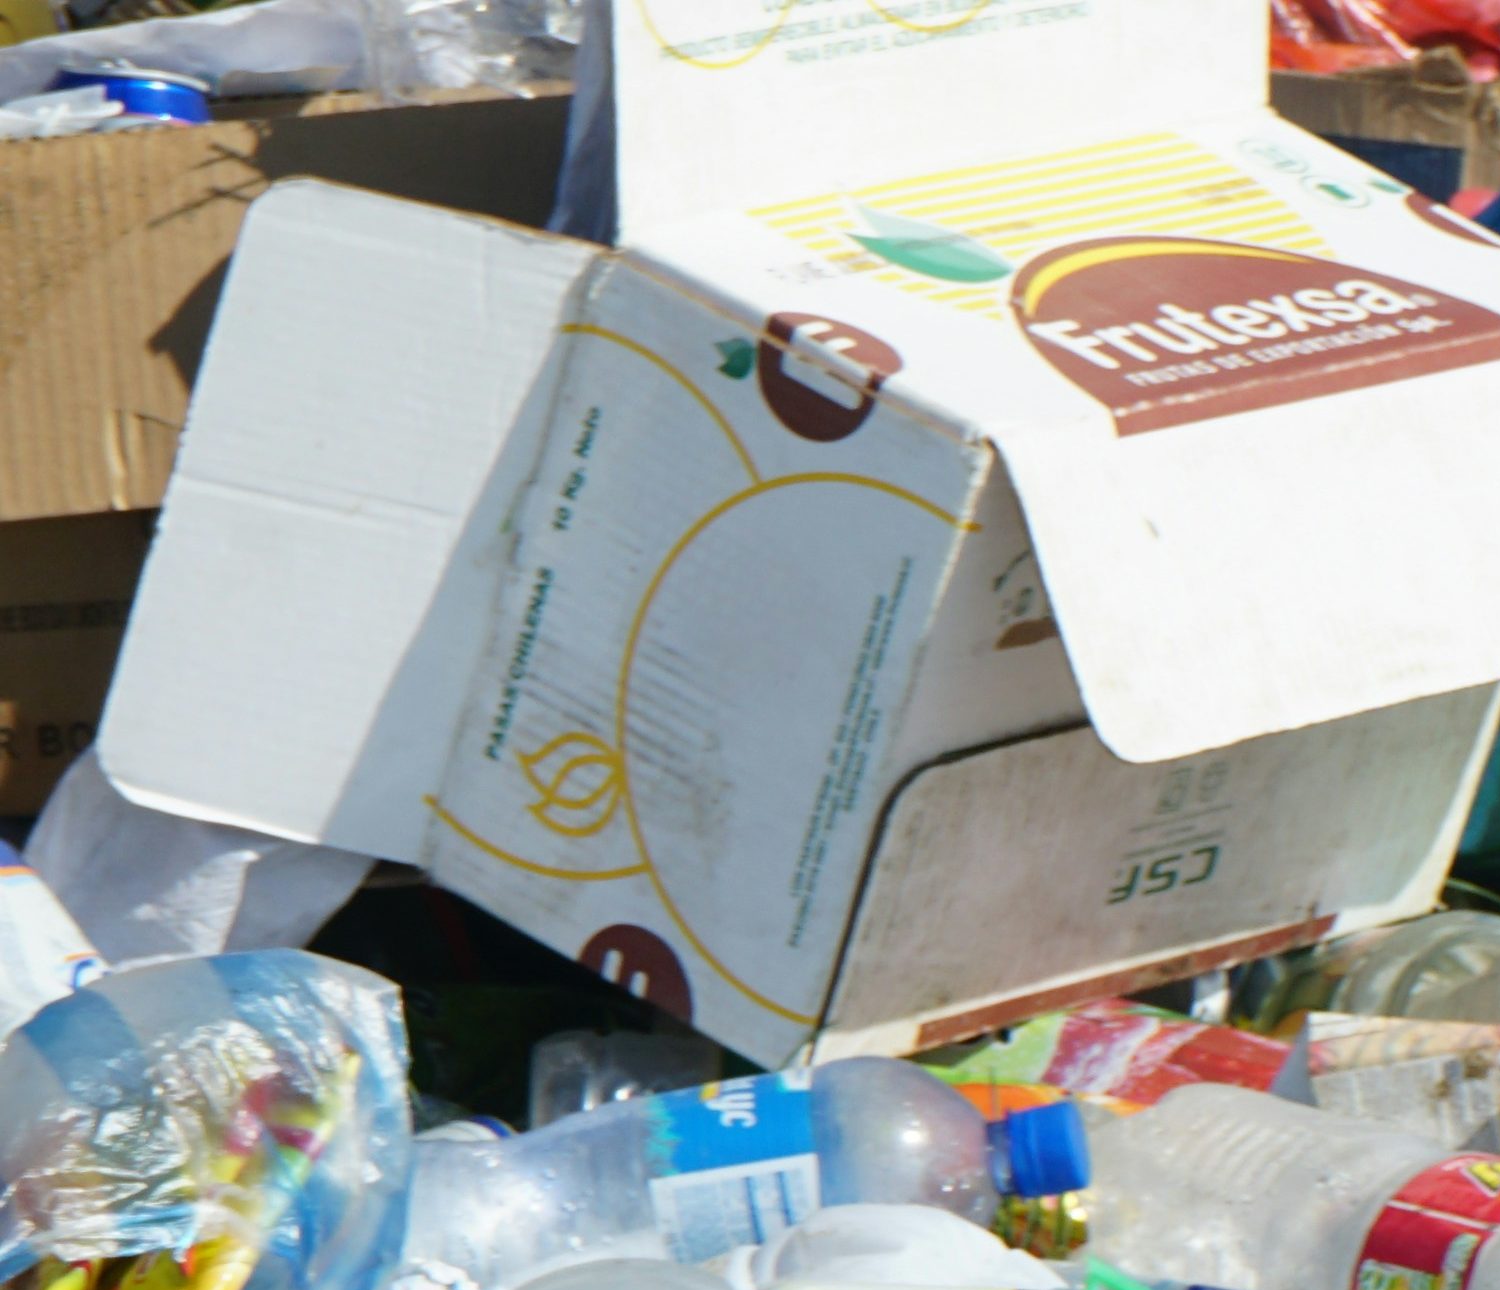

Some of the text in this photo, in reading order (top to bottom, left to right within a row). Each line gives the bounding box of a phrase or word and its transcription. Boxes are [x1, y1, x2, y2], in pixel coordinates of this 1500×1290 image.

[1028, 279, 1410, 370] Frutexsa
[1124, 355, 1215, 388] FRUTAS
[552, 505, 573, 531] 10
[482, 566, 553, 760] PASAS CHILENAS
